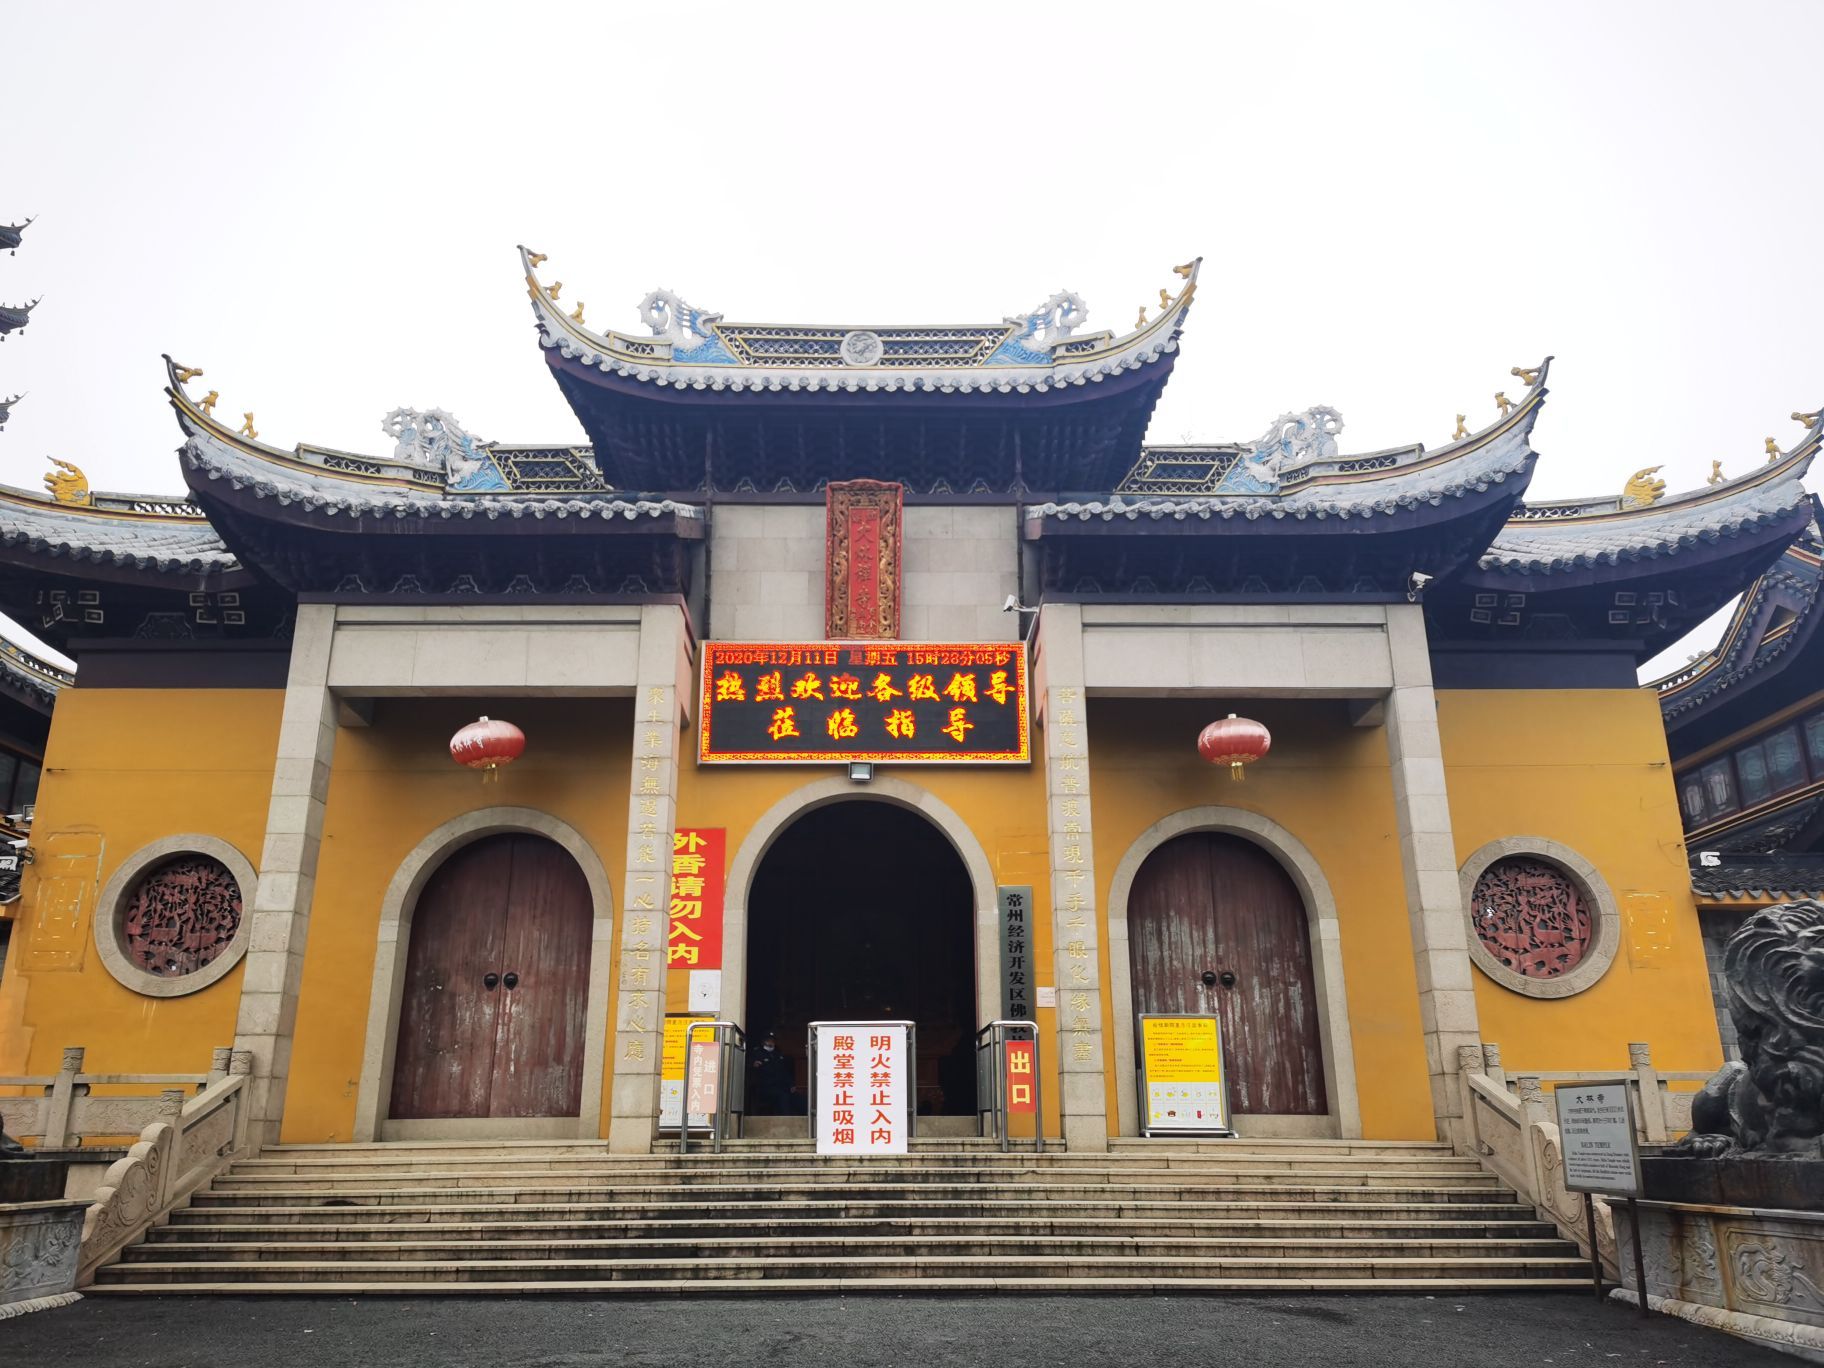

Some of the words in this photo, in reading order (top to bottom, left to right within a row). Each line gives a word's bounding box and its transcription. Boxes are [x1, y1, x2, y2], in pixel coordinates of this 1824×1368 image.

[715, 651, 838, 666] 2020年12月11日
[849, 651, 898, 666] 星期五
[715, 669, 1016, 704] 热烈欢迎各级领导
[767, 705, 975, 743] 莅临指导
[667, 831, 707, 965] 外香请勿入内
[704, 1060, 717, 1096] 进口
[832, 1035, 855, 1145] 殿堂禁止吸烟
[870, 1035, 892, 1145] 明火禁止入内
[1010, 1050, 1032, 1105] 出口
